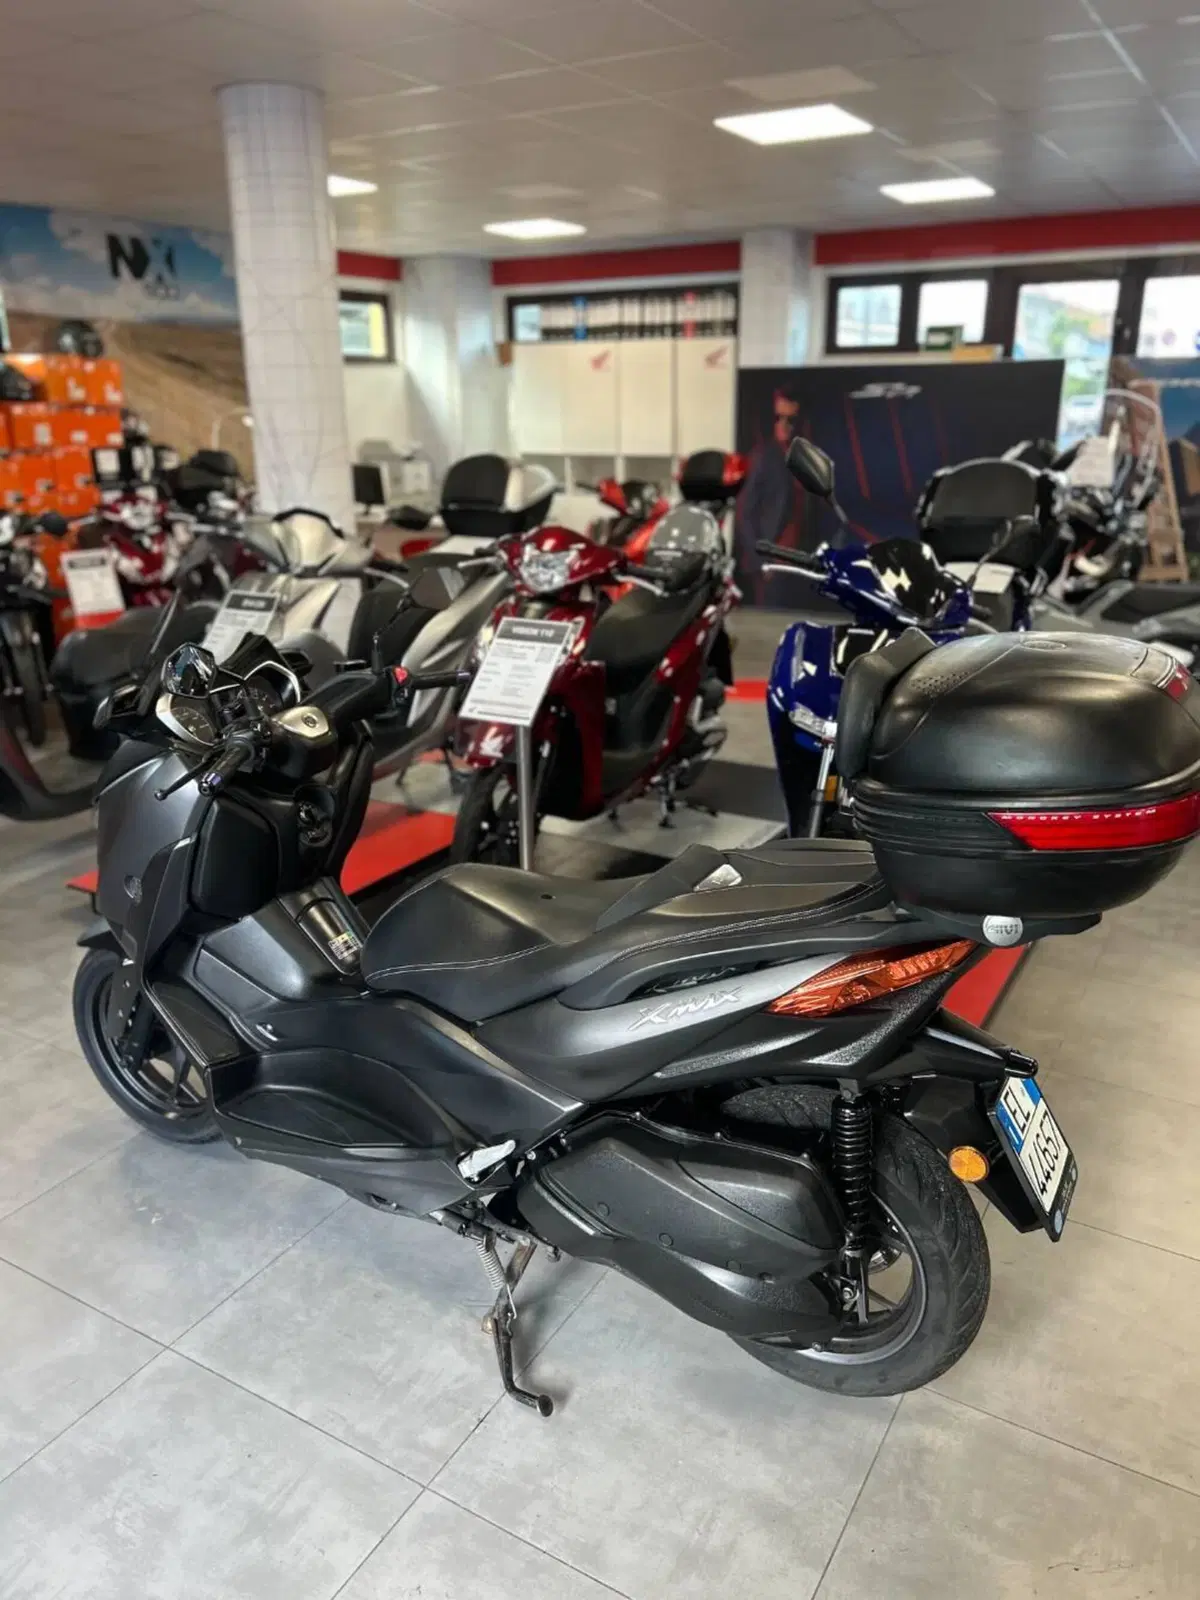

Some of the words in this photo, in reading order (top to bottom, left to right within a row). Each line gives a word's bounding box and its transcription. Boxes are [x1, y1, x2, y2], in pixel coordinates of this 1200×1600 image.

[106, 232, 177, 281] NX
[1092, 808, 1157, 820] SYSTEM
[1003, 1085, 1031, 1135] EL
[1028, 1109, 1061, 1197] 44657
